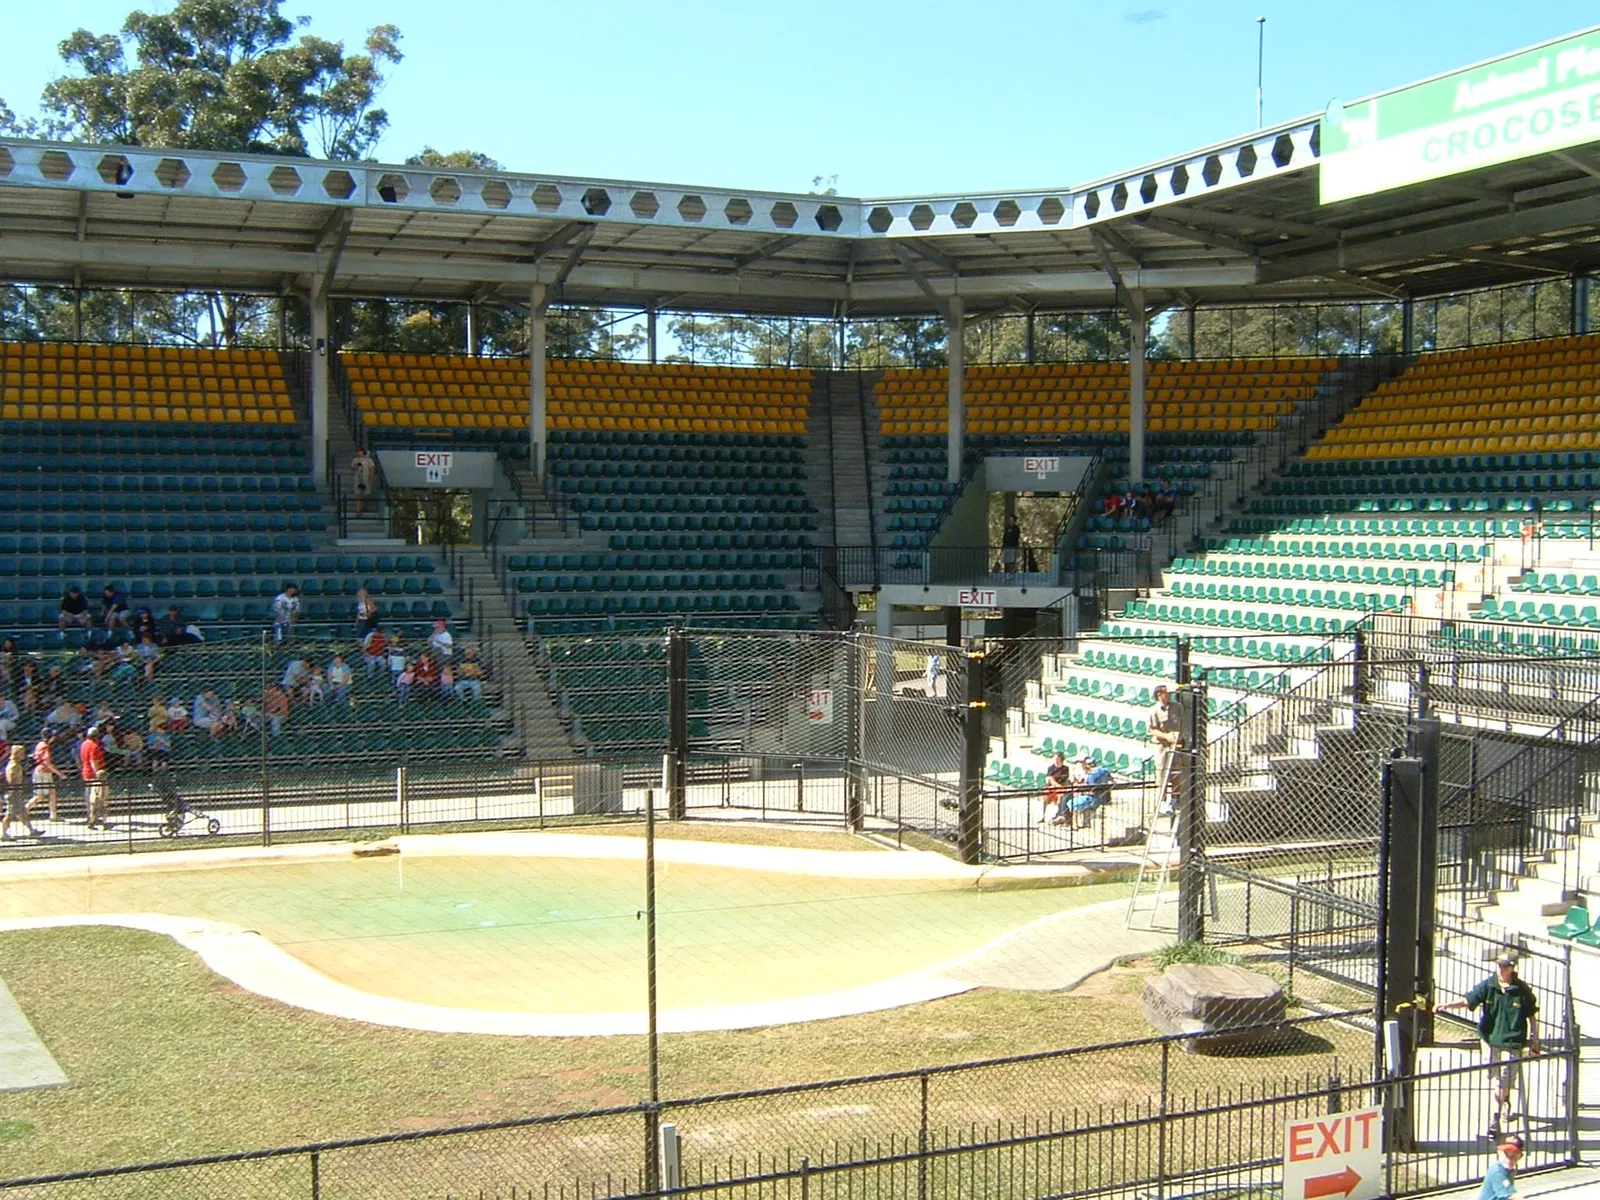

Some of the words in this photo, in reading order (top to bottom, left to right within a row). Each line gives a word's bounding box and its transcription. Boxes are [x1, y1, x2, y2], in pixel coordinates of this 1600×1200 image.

[1453, 56, 1549, 113] Animal
[417, 453, 451, 466] EXIT
[1025, 459, 1057, 471] EXIT
[960, 591, 995, 604] EXIT
[1289, 1111, 1378, 1162] EXIT
